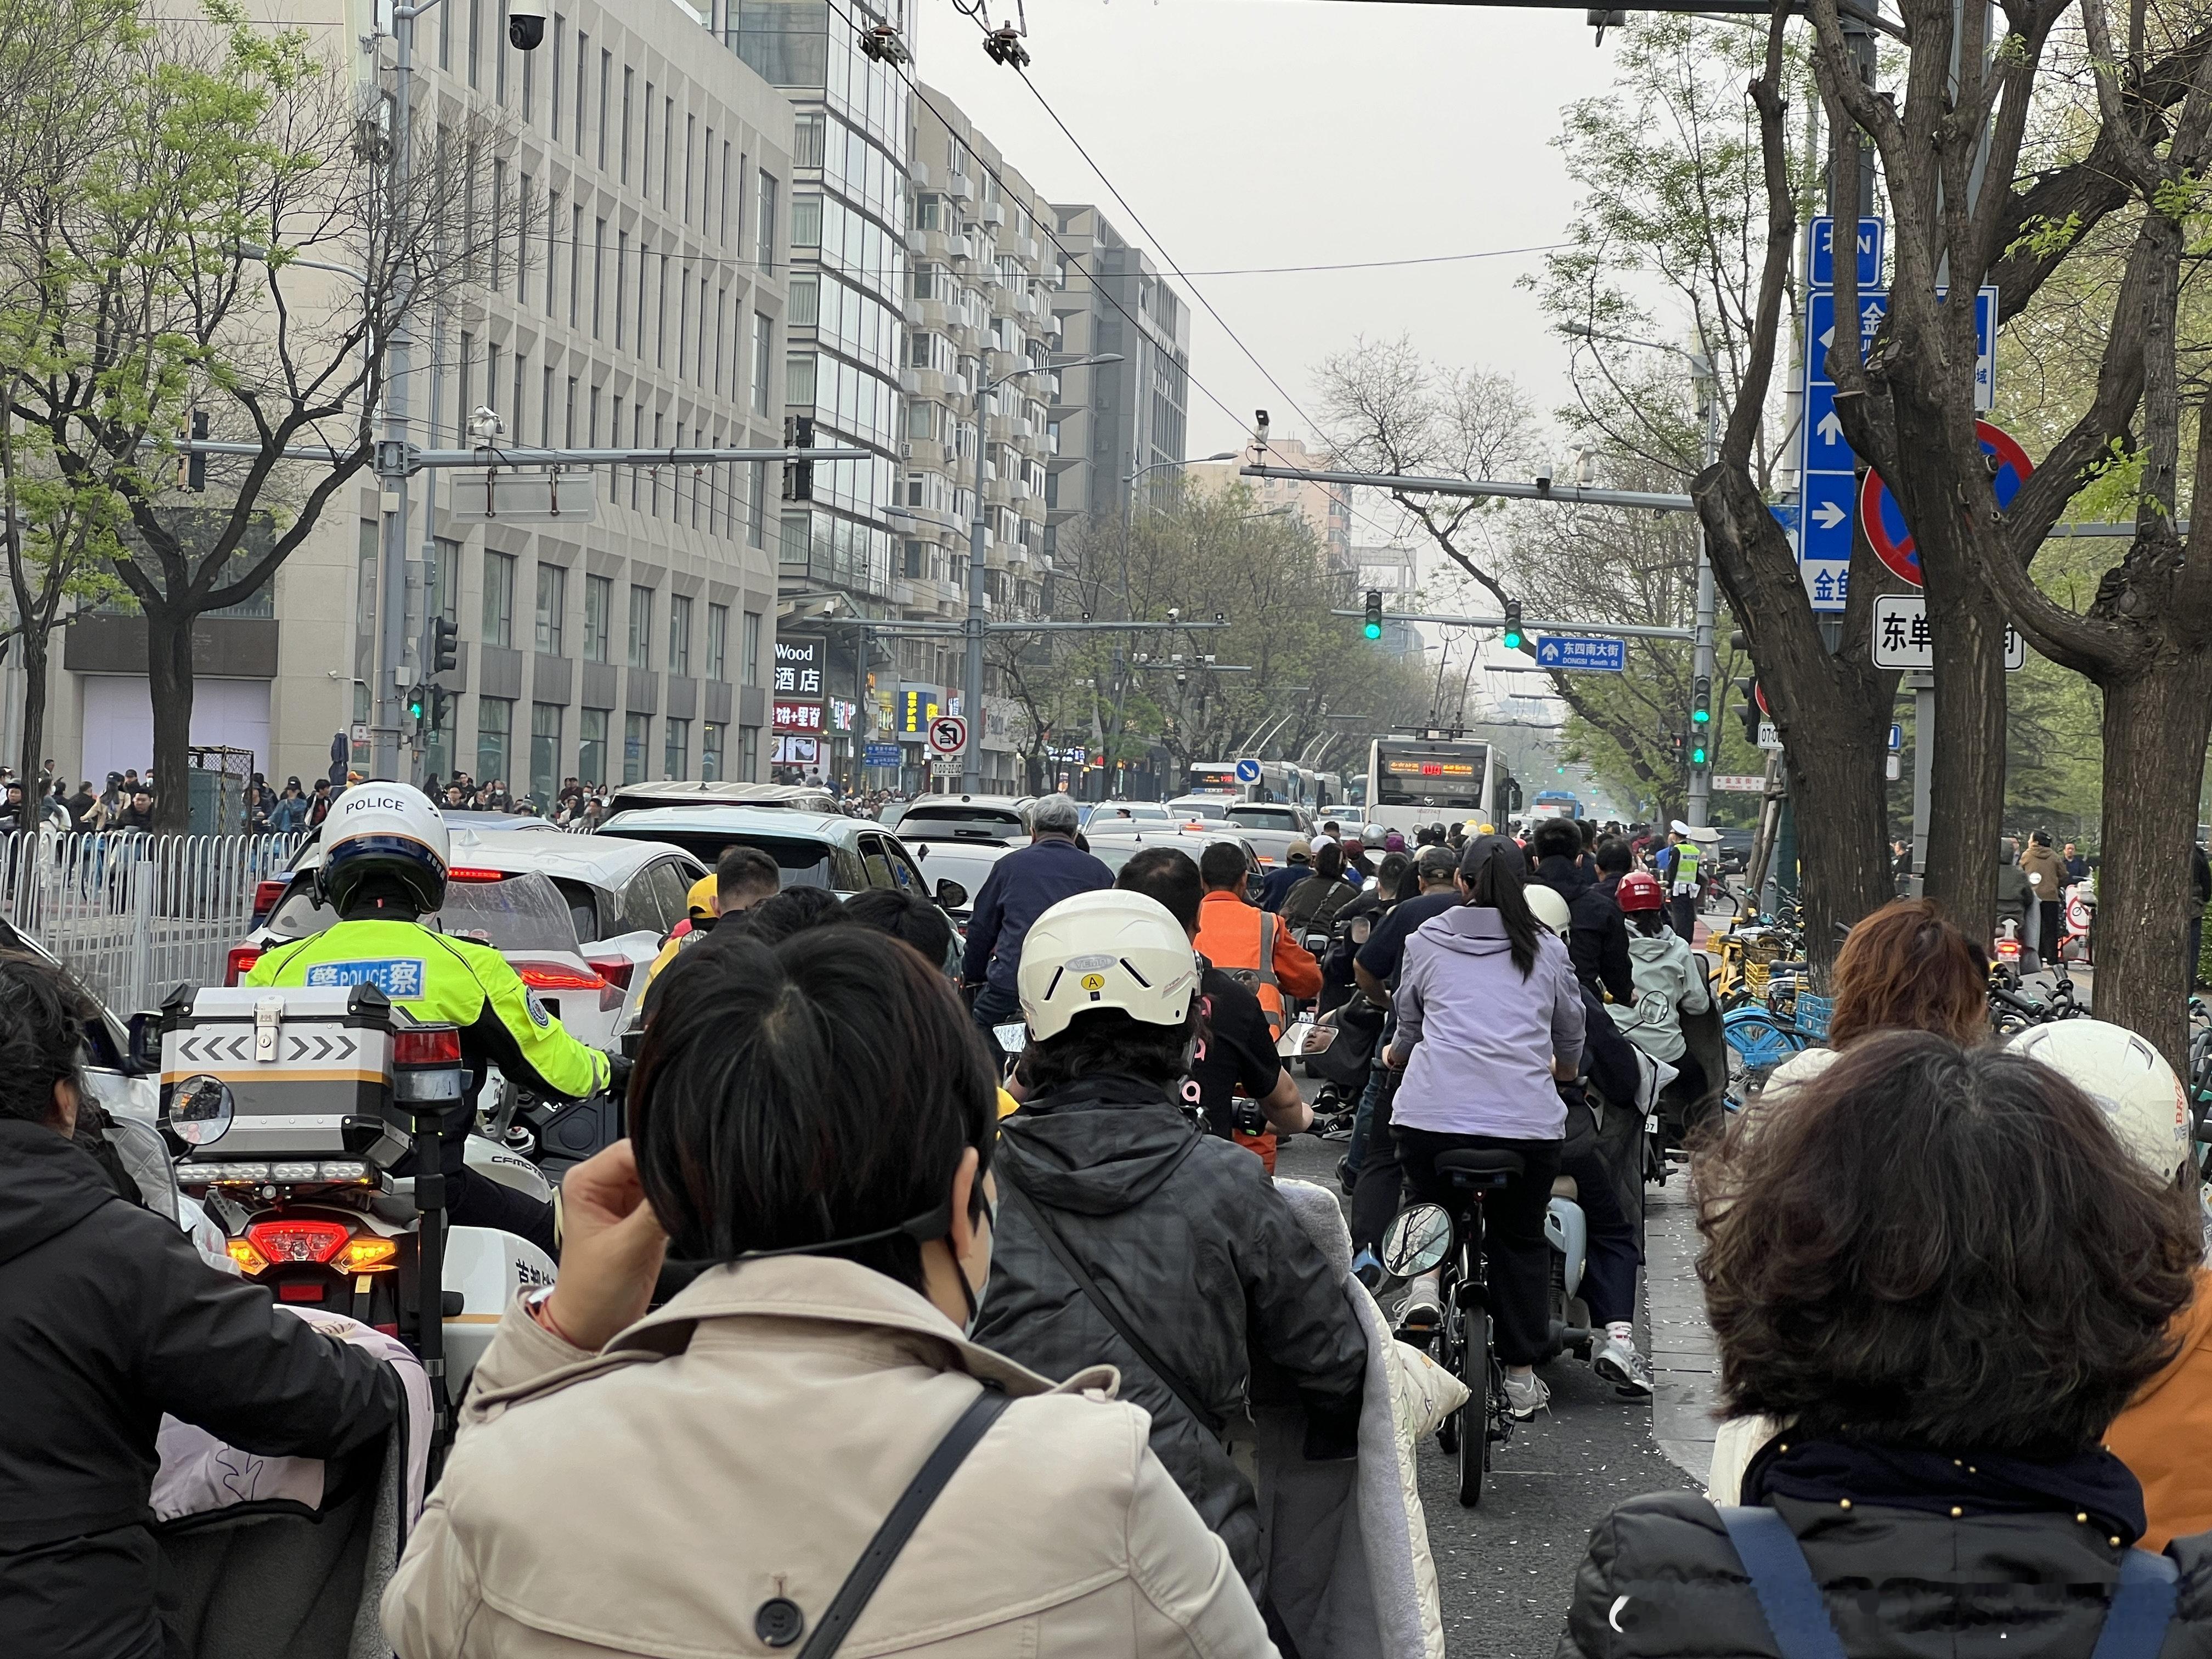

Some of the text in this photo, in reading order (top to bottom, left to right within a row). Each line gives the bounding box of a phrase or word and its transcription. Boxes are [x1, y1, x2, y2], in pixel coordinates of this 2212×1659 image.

[775, 643, 813, 661] Wood
[1563, 642, 1619, 657] 东四南大街
[775, 667, 820, 692] 酒店
[772, 706, 821, 728] 饼+里脊
[1422, 765, 1442, 775] 104
[346, 797, 404, 815] POLICE
[340, 968, 387, 988] POLICE
[389, 962, 417, 994] 察
[1088, 977, 1099, 988] A
[491, 1156, 544, 1180] CFMOTO
